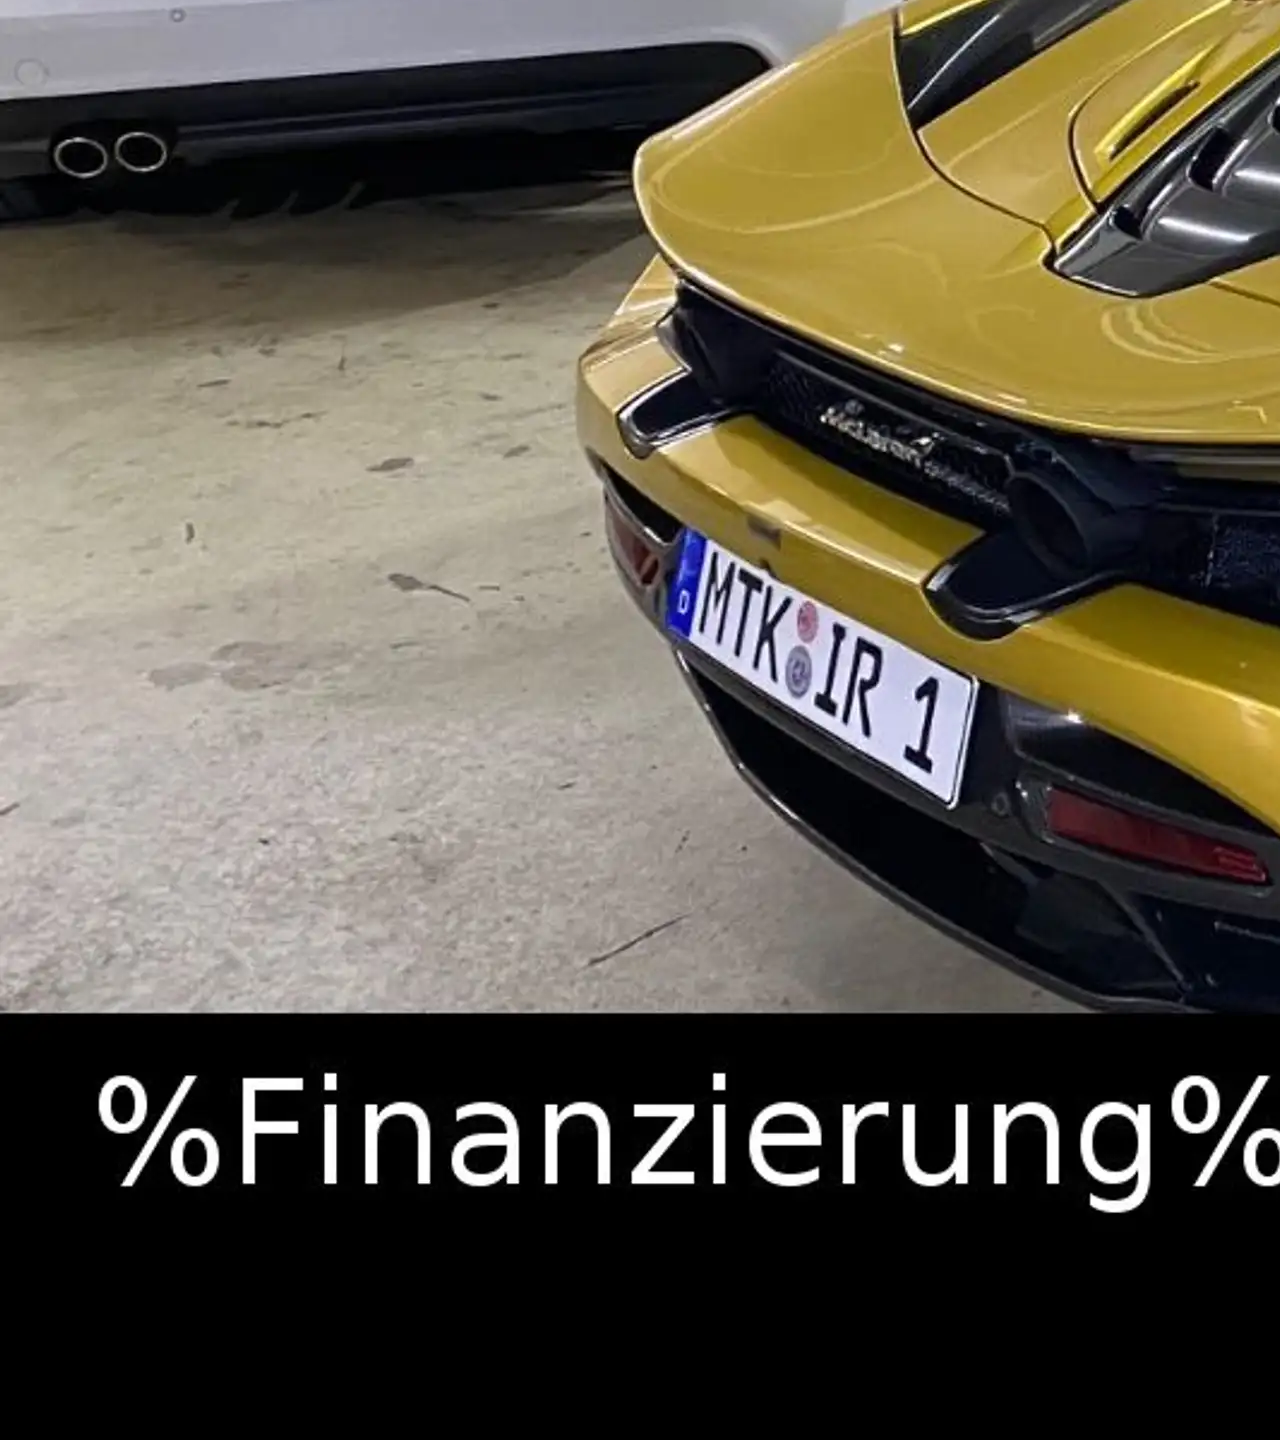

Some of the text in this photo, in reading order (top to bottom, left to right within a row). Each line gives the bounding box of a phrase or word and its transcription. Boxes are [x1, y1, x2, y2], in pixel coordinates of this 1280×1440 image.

[699, 550, 793, 683] MTK
[813, 621, 883, 738] IR
[903, 675, 940, 774] 1
